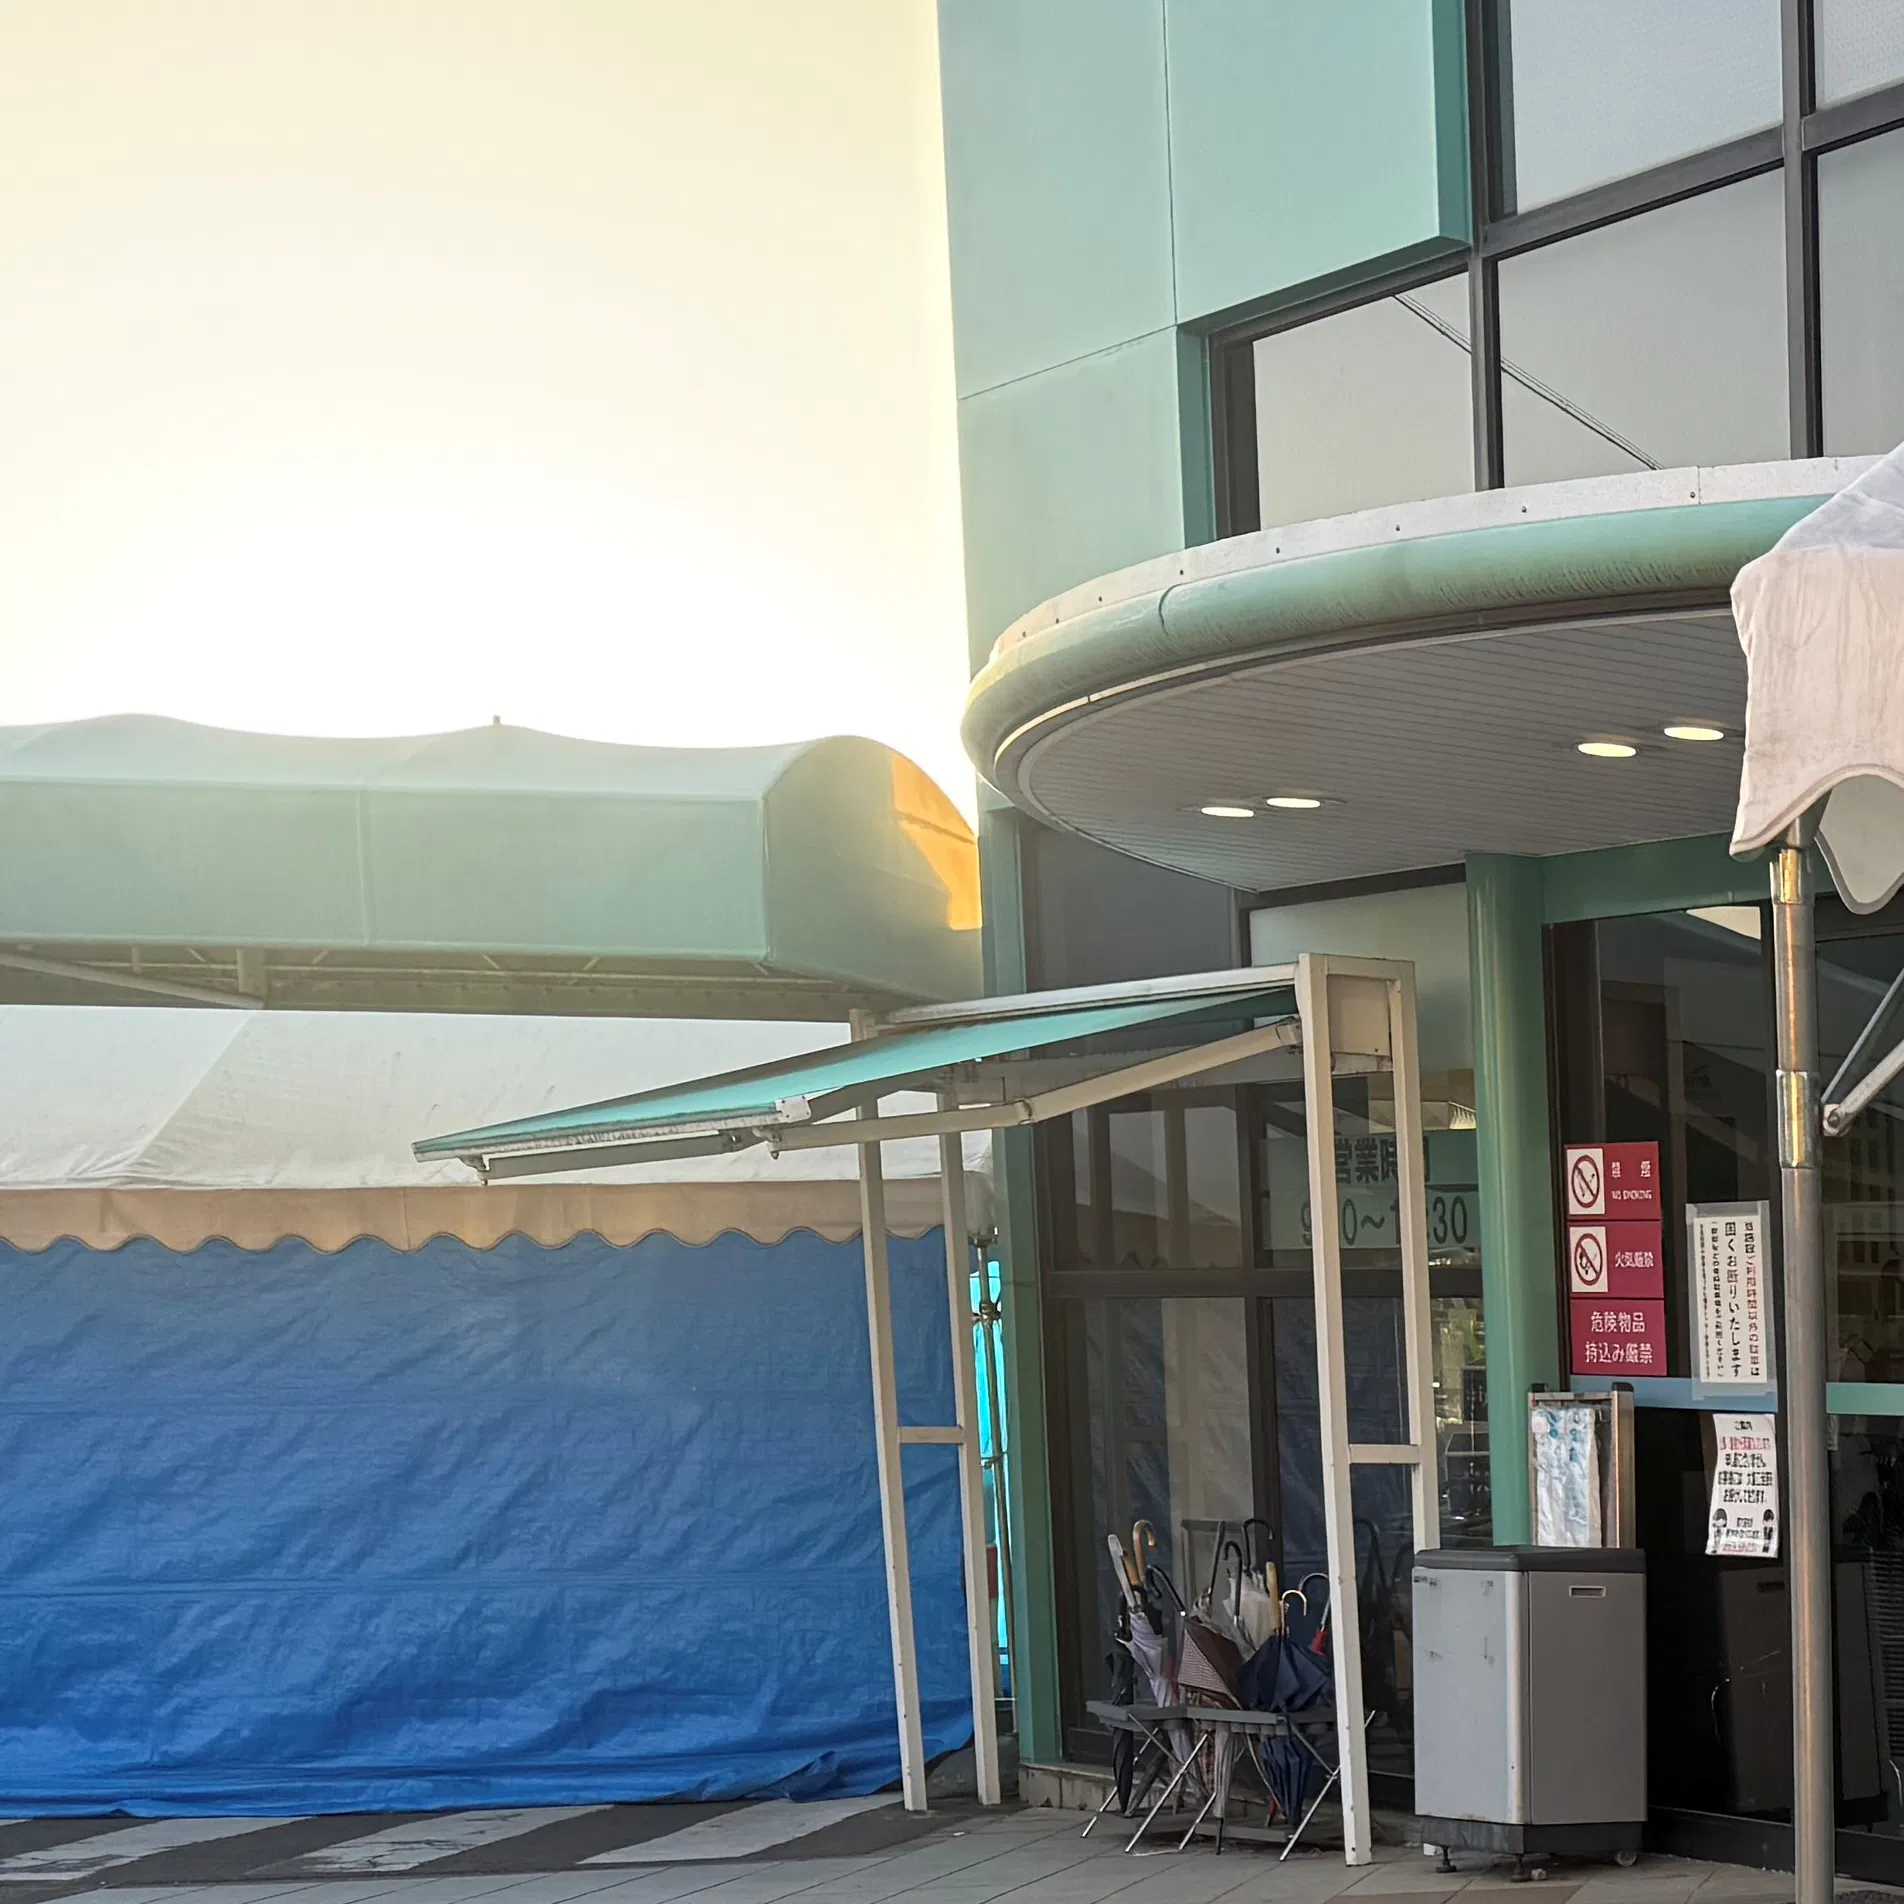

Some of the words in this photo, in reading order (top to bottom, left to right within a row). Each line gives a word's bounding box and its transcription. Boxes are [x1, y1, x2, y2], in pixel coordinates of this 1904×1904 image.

[1591, 1311, 1646, 1334] 危険物品
[1585, 1341, 1653, 1364] 持込み厳禁
